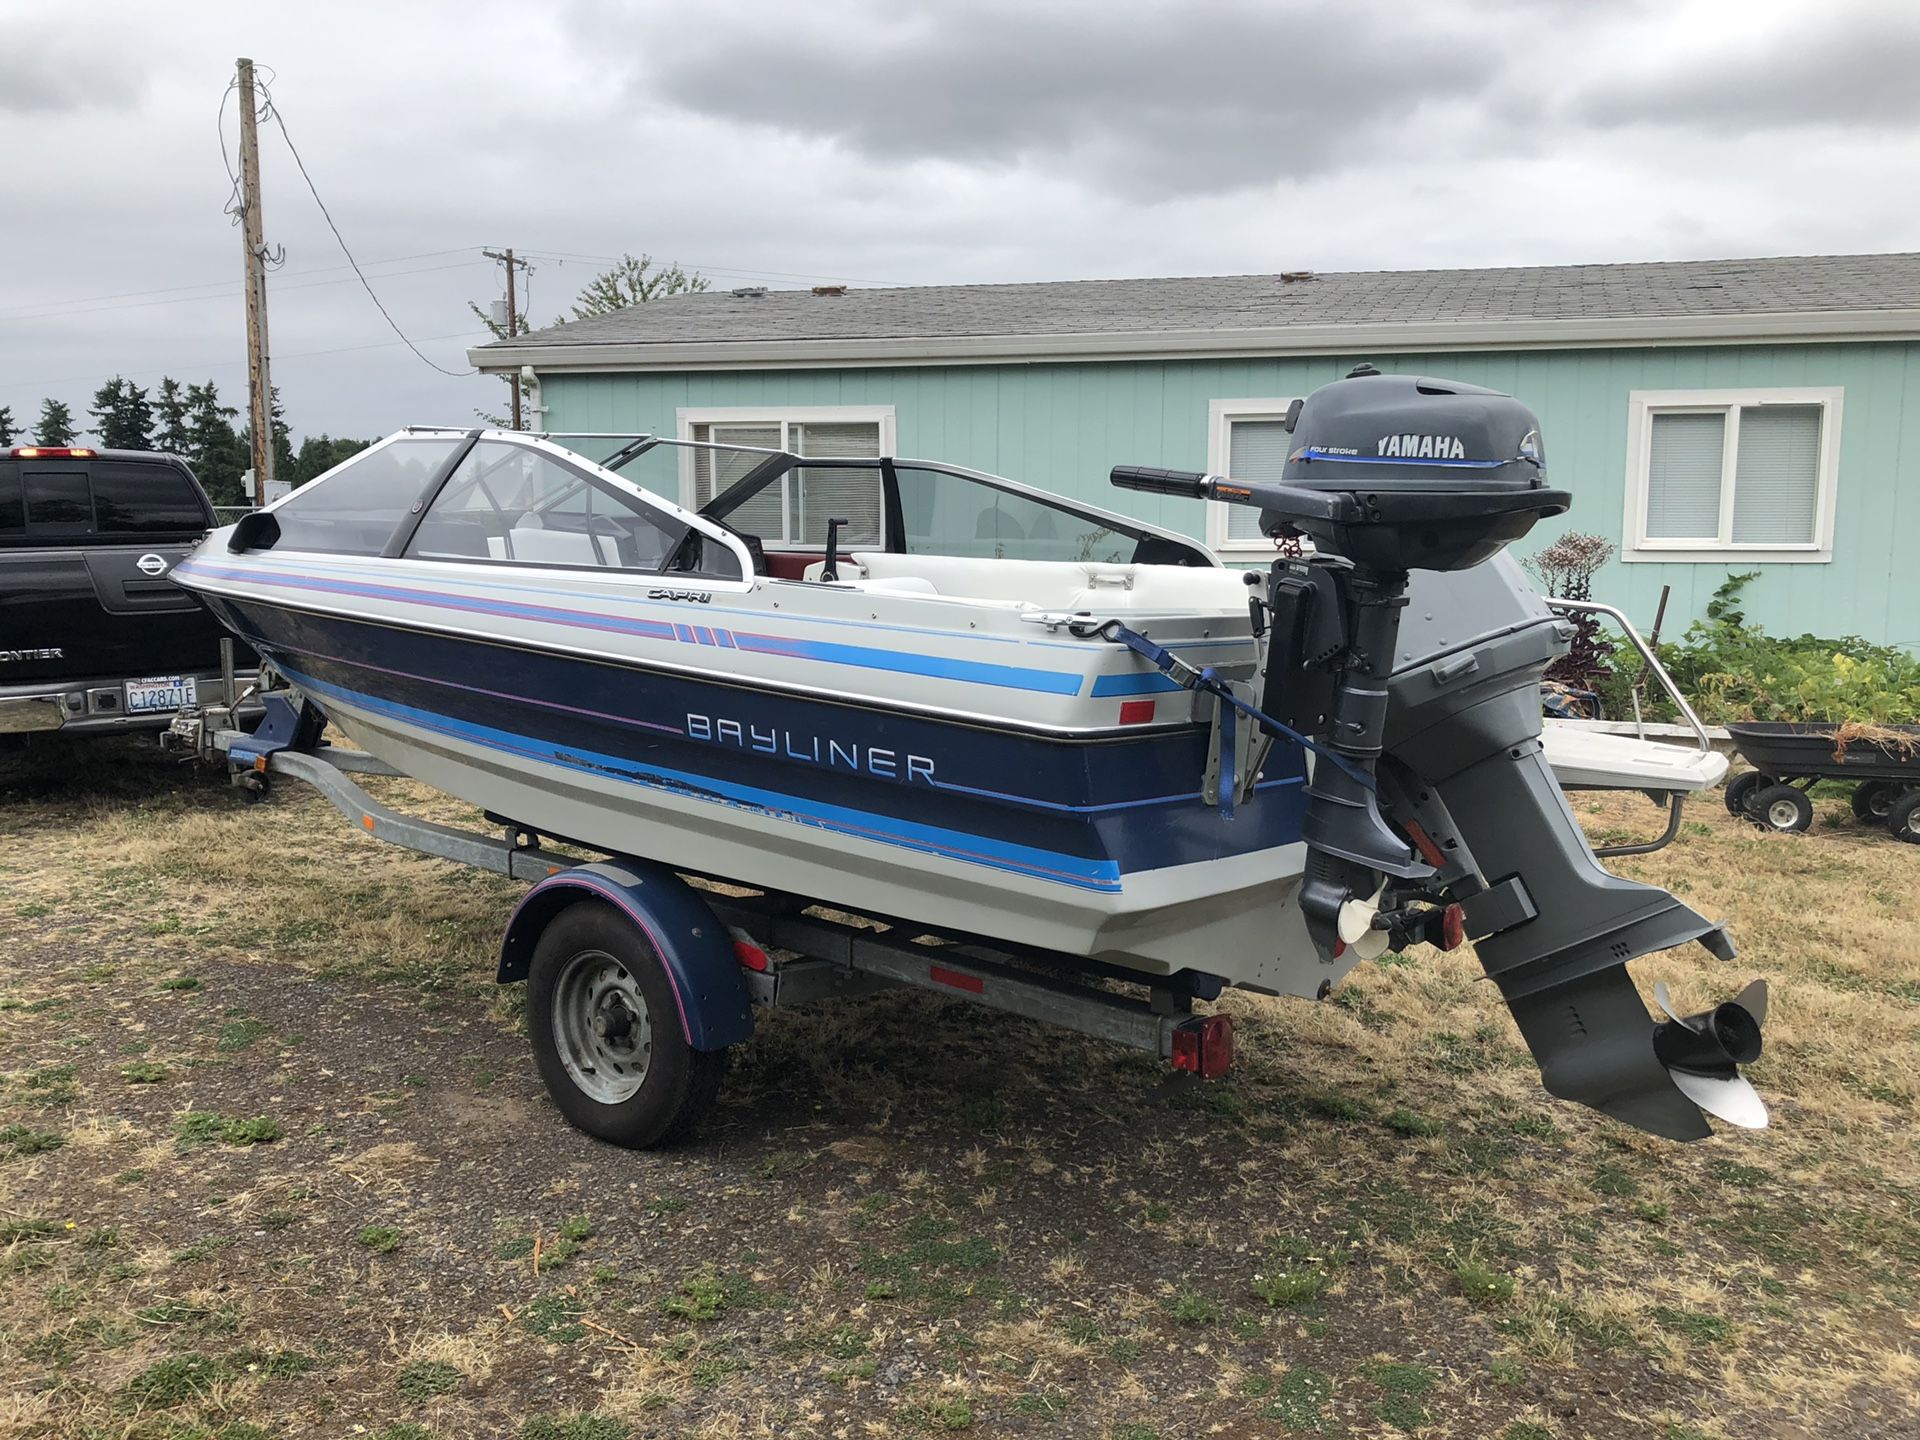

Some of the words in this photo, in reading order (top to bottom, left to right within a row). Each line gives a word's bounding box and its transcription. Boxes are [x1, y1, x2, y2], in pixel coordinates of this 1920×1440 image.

[1377, 434, 1465, 459] YAMAHA
[647, 589, 712, 604] CAPRI
[687, 713, 936, 786] BAYLINER
